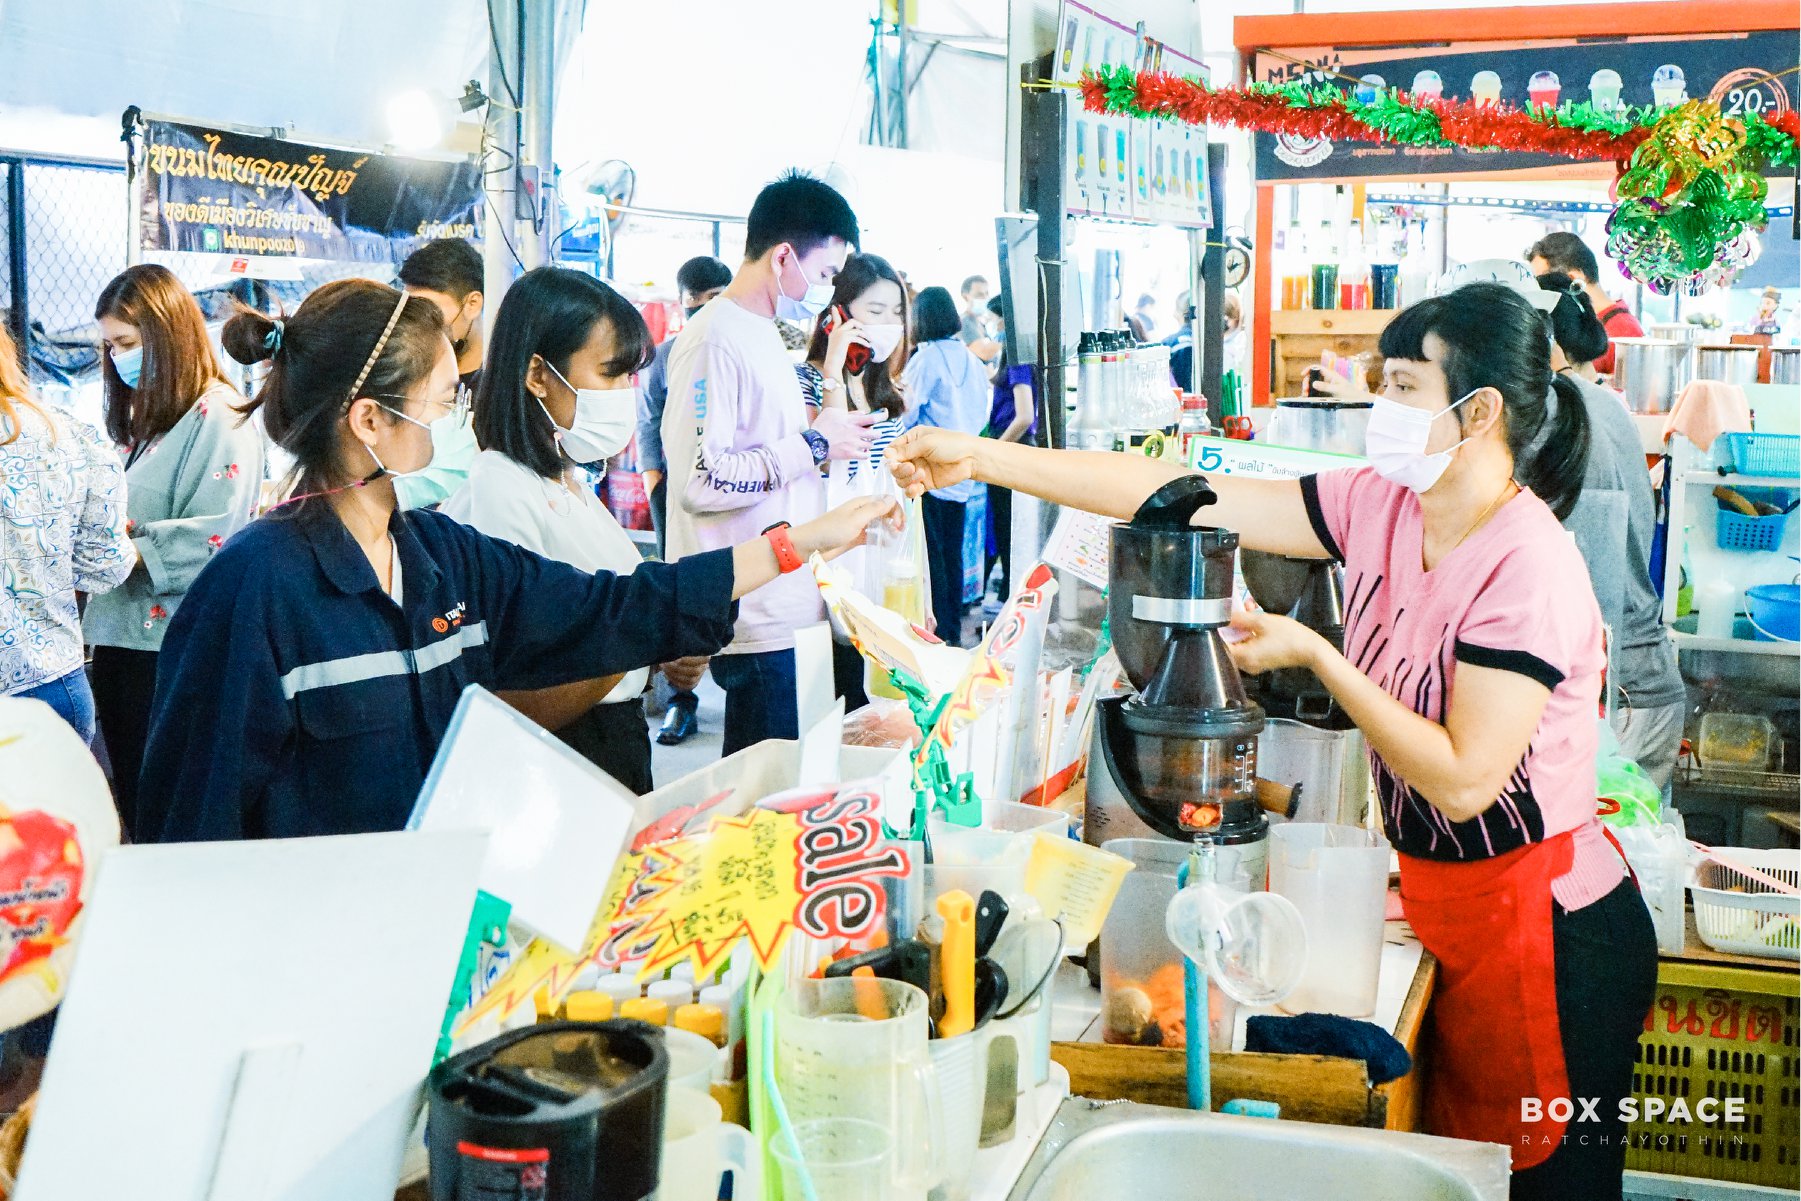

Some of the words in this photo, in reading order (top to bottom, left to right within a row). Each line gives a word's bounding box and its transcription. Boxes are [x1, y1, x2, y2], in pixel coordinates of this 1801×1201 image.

[1728, 88, 1776, 116] 20.-
[694, 378, 708, 419] USA
[801, 796, 902, 935] sale
